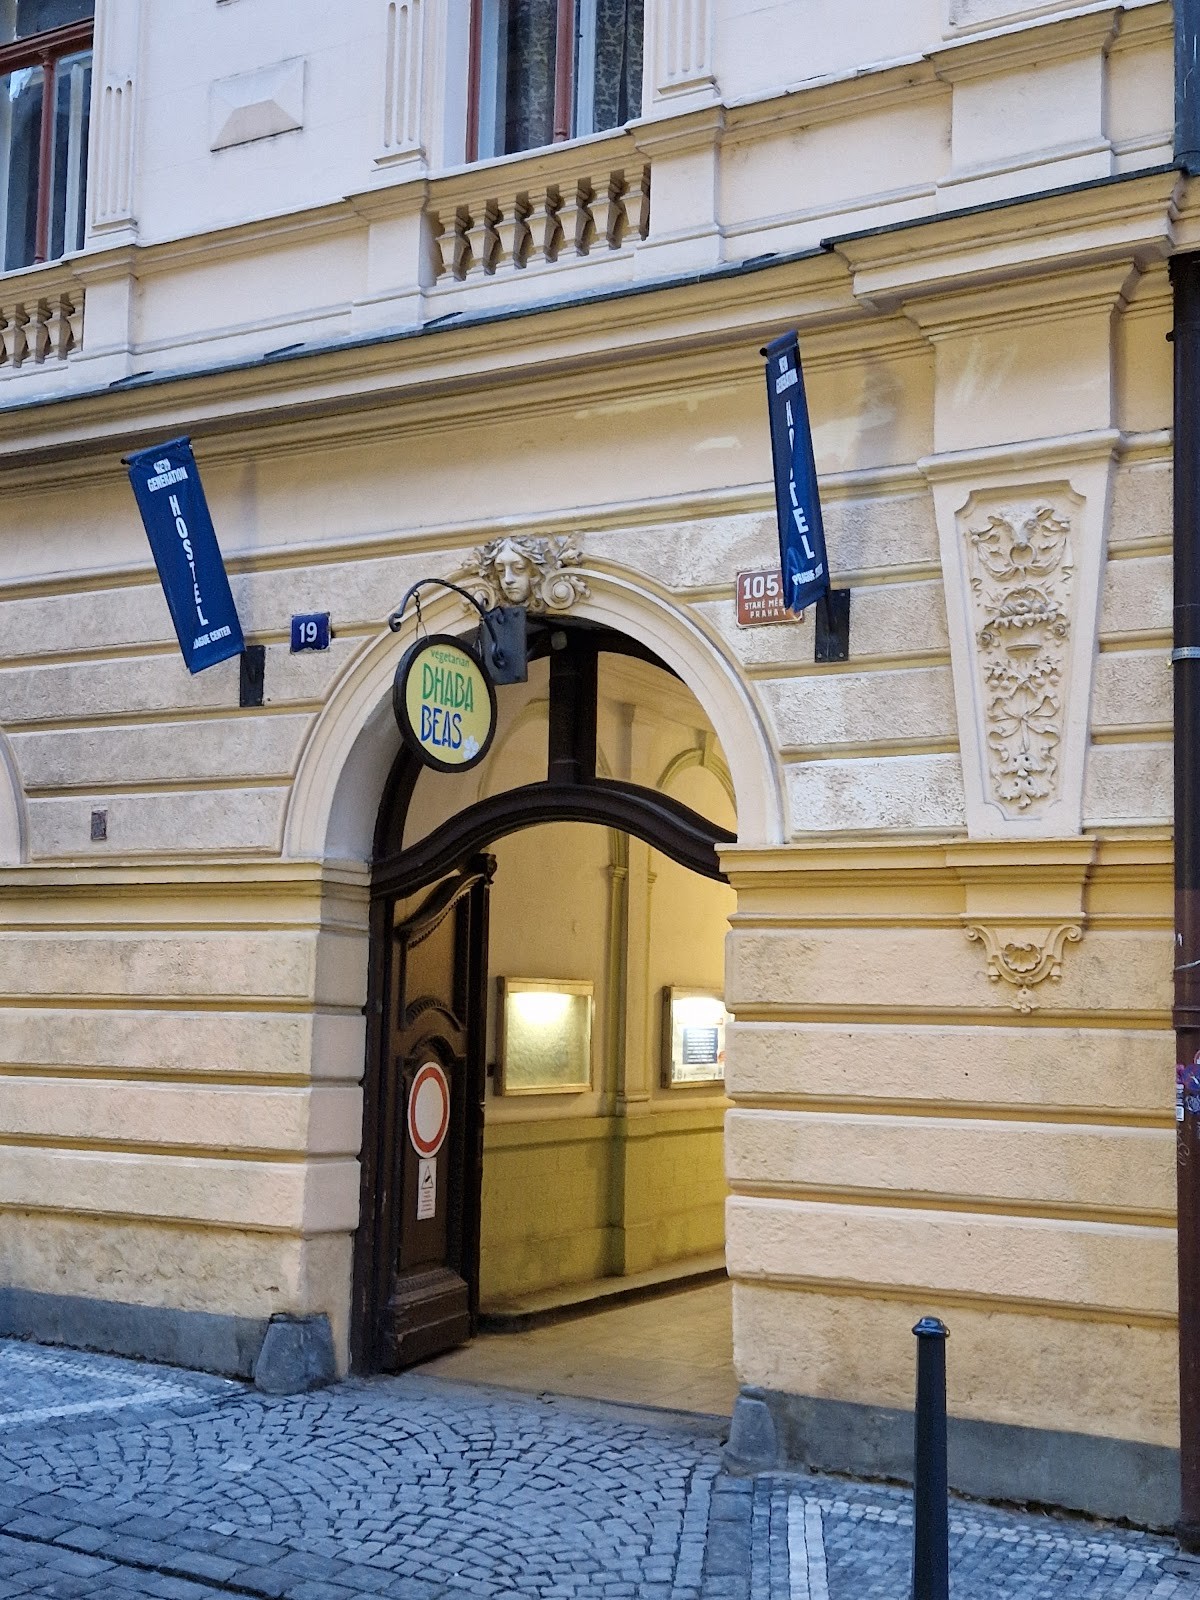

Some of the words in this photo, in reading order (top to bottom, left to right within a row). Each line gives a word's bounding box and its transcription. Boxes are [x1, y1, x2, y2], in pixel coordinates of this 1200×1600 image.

[154, 458, 171, 474] NEW
[147, 466, 189, 493] GENERATION
[168, 494, 209, 626] HOSTEL
[743, 574, 784, 600] 105
[744, 599, 766, 611] STARÉ
[750, 608, 779, 619] PRAHA
[210, 625, 231, 641] CENTER
[298, 621, 319, 644] 19
[431, 650, 470, 668] vegetarian
[423, 663, 473, 712] DHABA
[421, 705, 462, 749] BEAS
